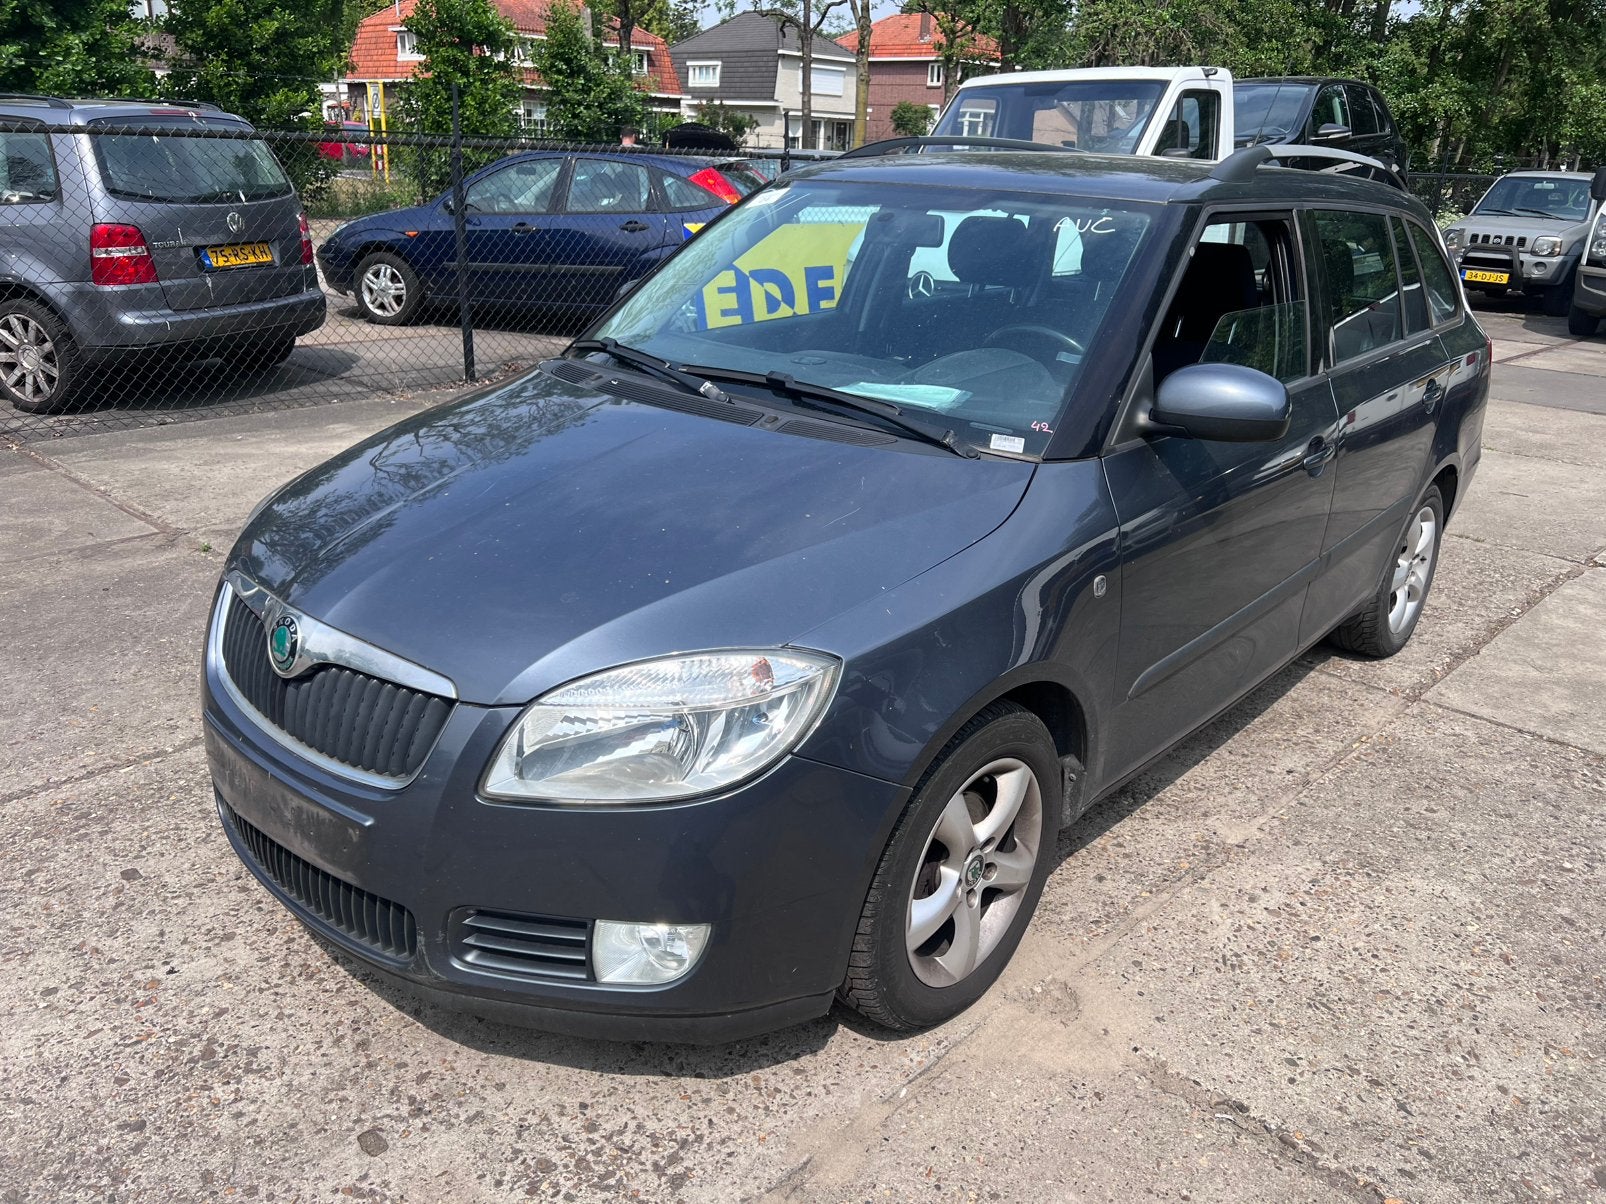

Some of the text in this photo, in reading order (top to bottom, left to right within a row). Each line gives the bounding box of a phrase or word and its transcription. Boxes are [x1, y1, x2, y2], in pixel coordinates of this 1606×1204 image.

[210, 245, 269, 264] 75-RS-KH
[1467, 271, 1504, 282] 34-DJ-JS
[1031, 420, 1053, 434] 42
